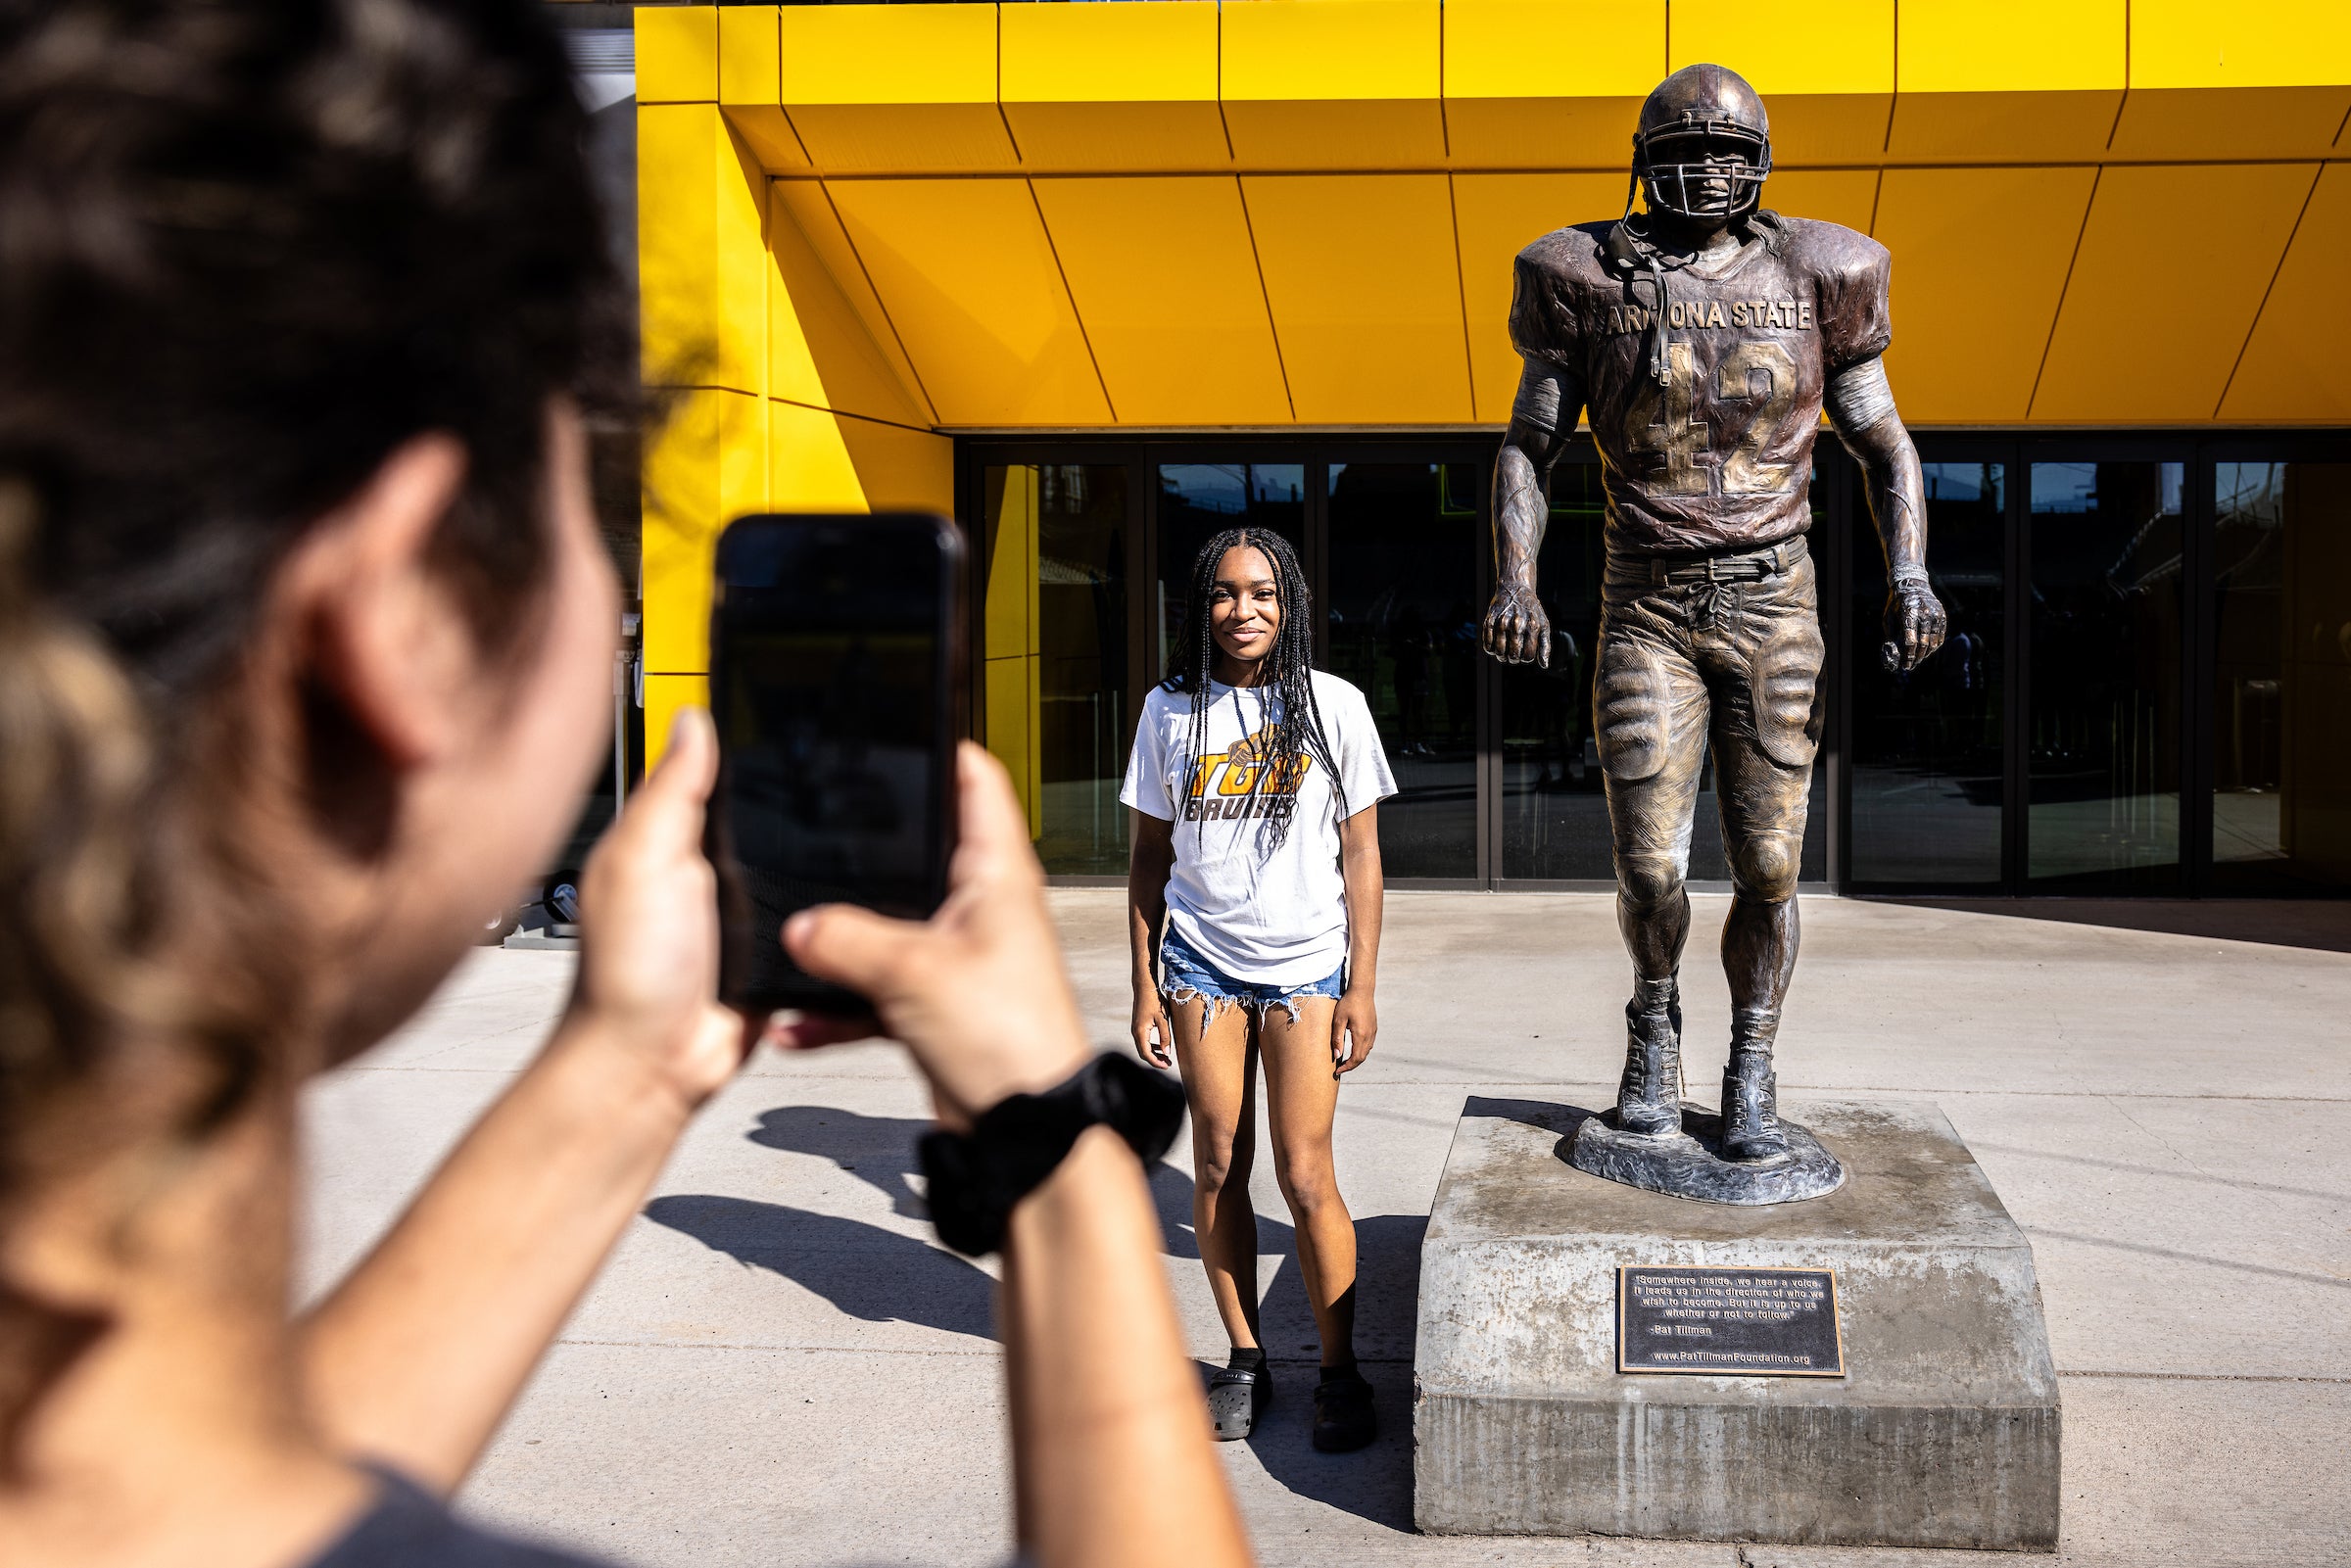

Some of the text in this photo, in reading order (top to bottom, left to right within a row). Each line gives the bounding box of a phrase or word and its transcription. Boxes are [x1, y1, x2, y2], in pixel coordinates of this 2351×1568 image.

[1606, 302, 1812, 335] ARIONA STATE
[1626, 342, 1798, 498] 42
[1635, 1275, 1696, 1285] "Somewhere
[1700, 1276, 1733, 1286] inside,
[1755, 1277, 1777, 1287] hear
[1634, 1286, 1641, 1295] It
[1645, 1286, 1672, 1296] leads
[1692, 1287, 1701, 1296] in
[1704, 1287, 1721, 1296] the
[1725, 1288, 1768, 1298] direction
[1772, 1289, 1782, 1298] of
[1786, 1289, 1806, 1299] who
[1683, 1298, 1724, 1307] become.
[1729, 1298, 1746, 1307] But
[1750, 1299, 1756, 1307] it
[1774, 1301, 1786, 1309] up
[1664, 1308, 1704, 1318] whether
[1723, 1309, 1739, 1318] not
[1757, 1310, 1795, 1319] follow."
[1650, 1325, 1712, 1336] -Pat Tillman
[1654, 1352, 1810, 1365] www.PatTillmanFoundation.org
